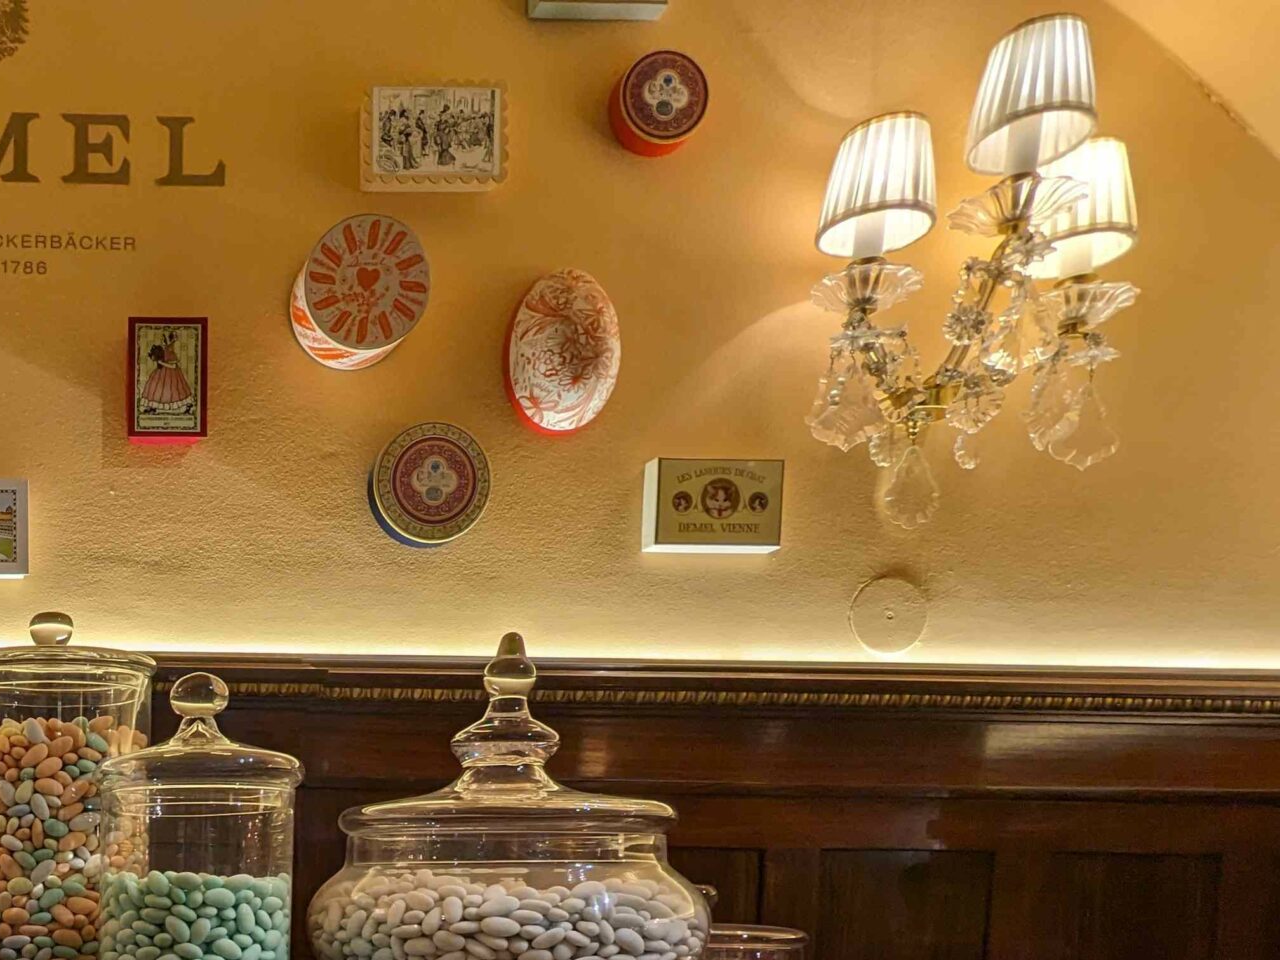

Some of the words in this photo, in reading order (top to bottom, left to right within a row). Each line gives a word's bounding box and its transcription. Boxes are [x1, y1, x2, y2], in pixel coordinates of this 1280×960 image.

[1, 260, 48, 275] 1786
[676, 472, 693, 484] LES
[734, 467, 746, 478] DE
[678, 522, 717, 533] DEMEL
[720, 522, 761, 534] VIENNE
